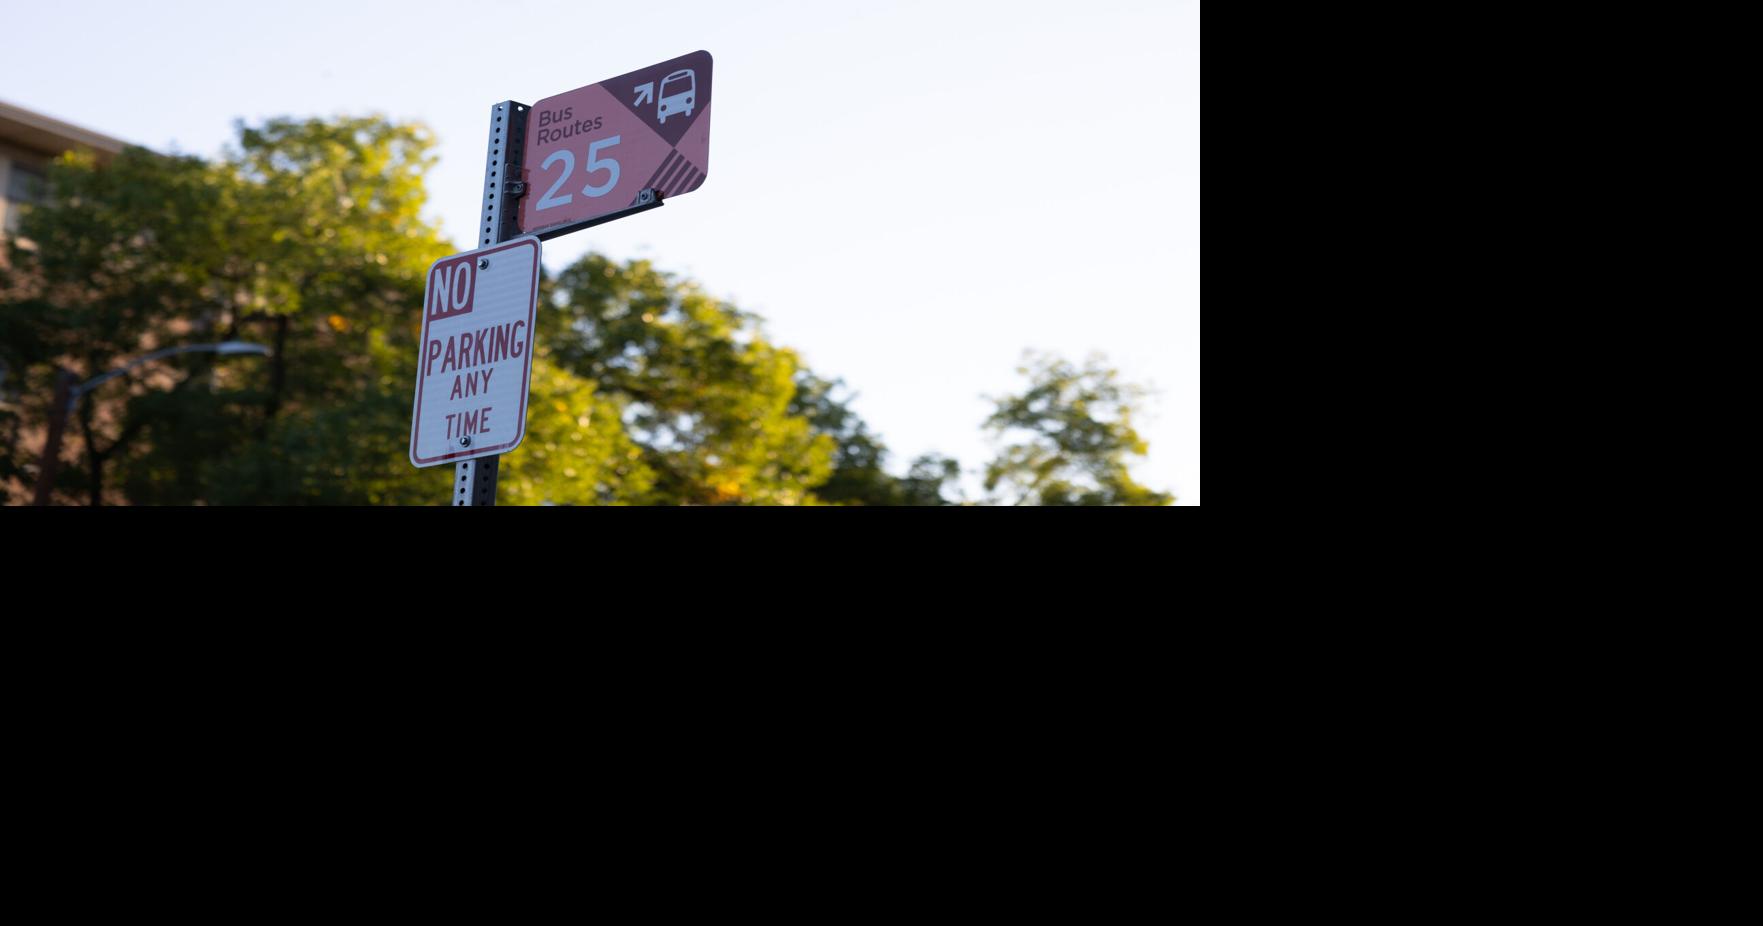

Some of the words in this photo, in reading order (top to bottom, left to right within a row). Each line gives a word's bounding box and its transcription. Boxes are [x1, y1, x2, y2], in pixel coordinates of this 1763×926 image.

[537, 116, 603, 146] Routes
[538, 107, 573, 128] Bus
[535, 135, 621, 211] 25
[431, 262, 472, 316] NO
[426, 320, 525, 376] PARKING
[450, 368, 493, 400] ANY
[446, 407, 492, 440] TIME
